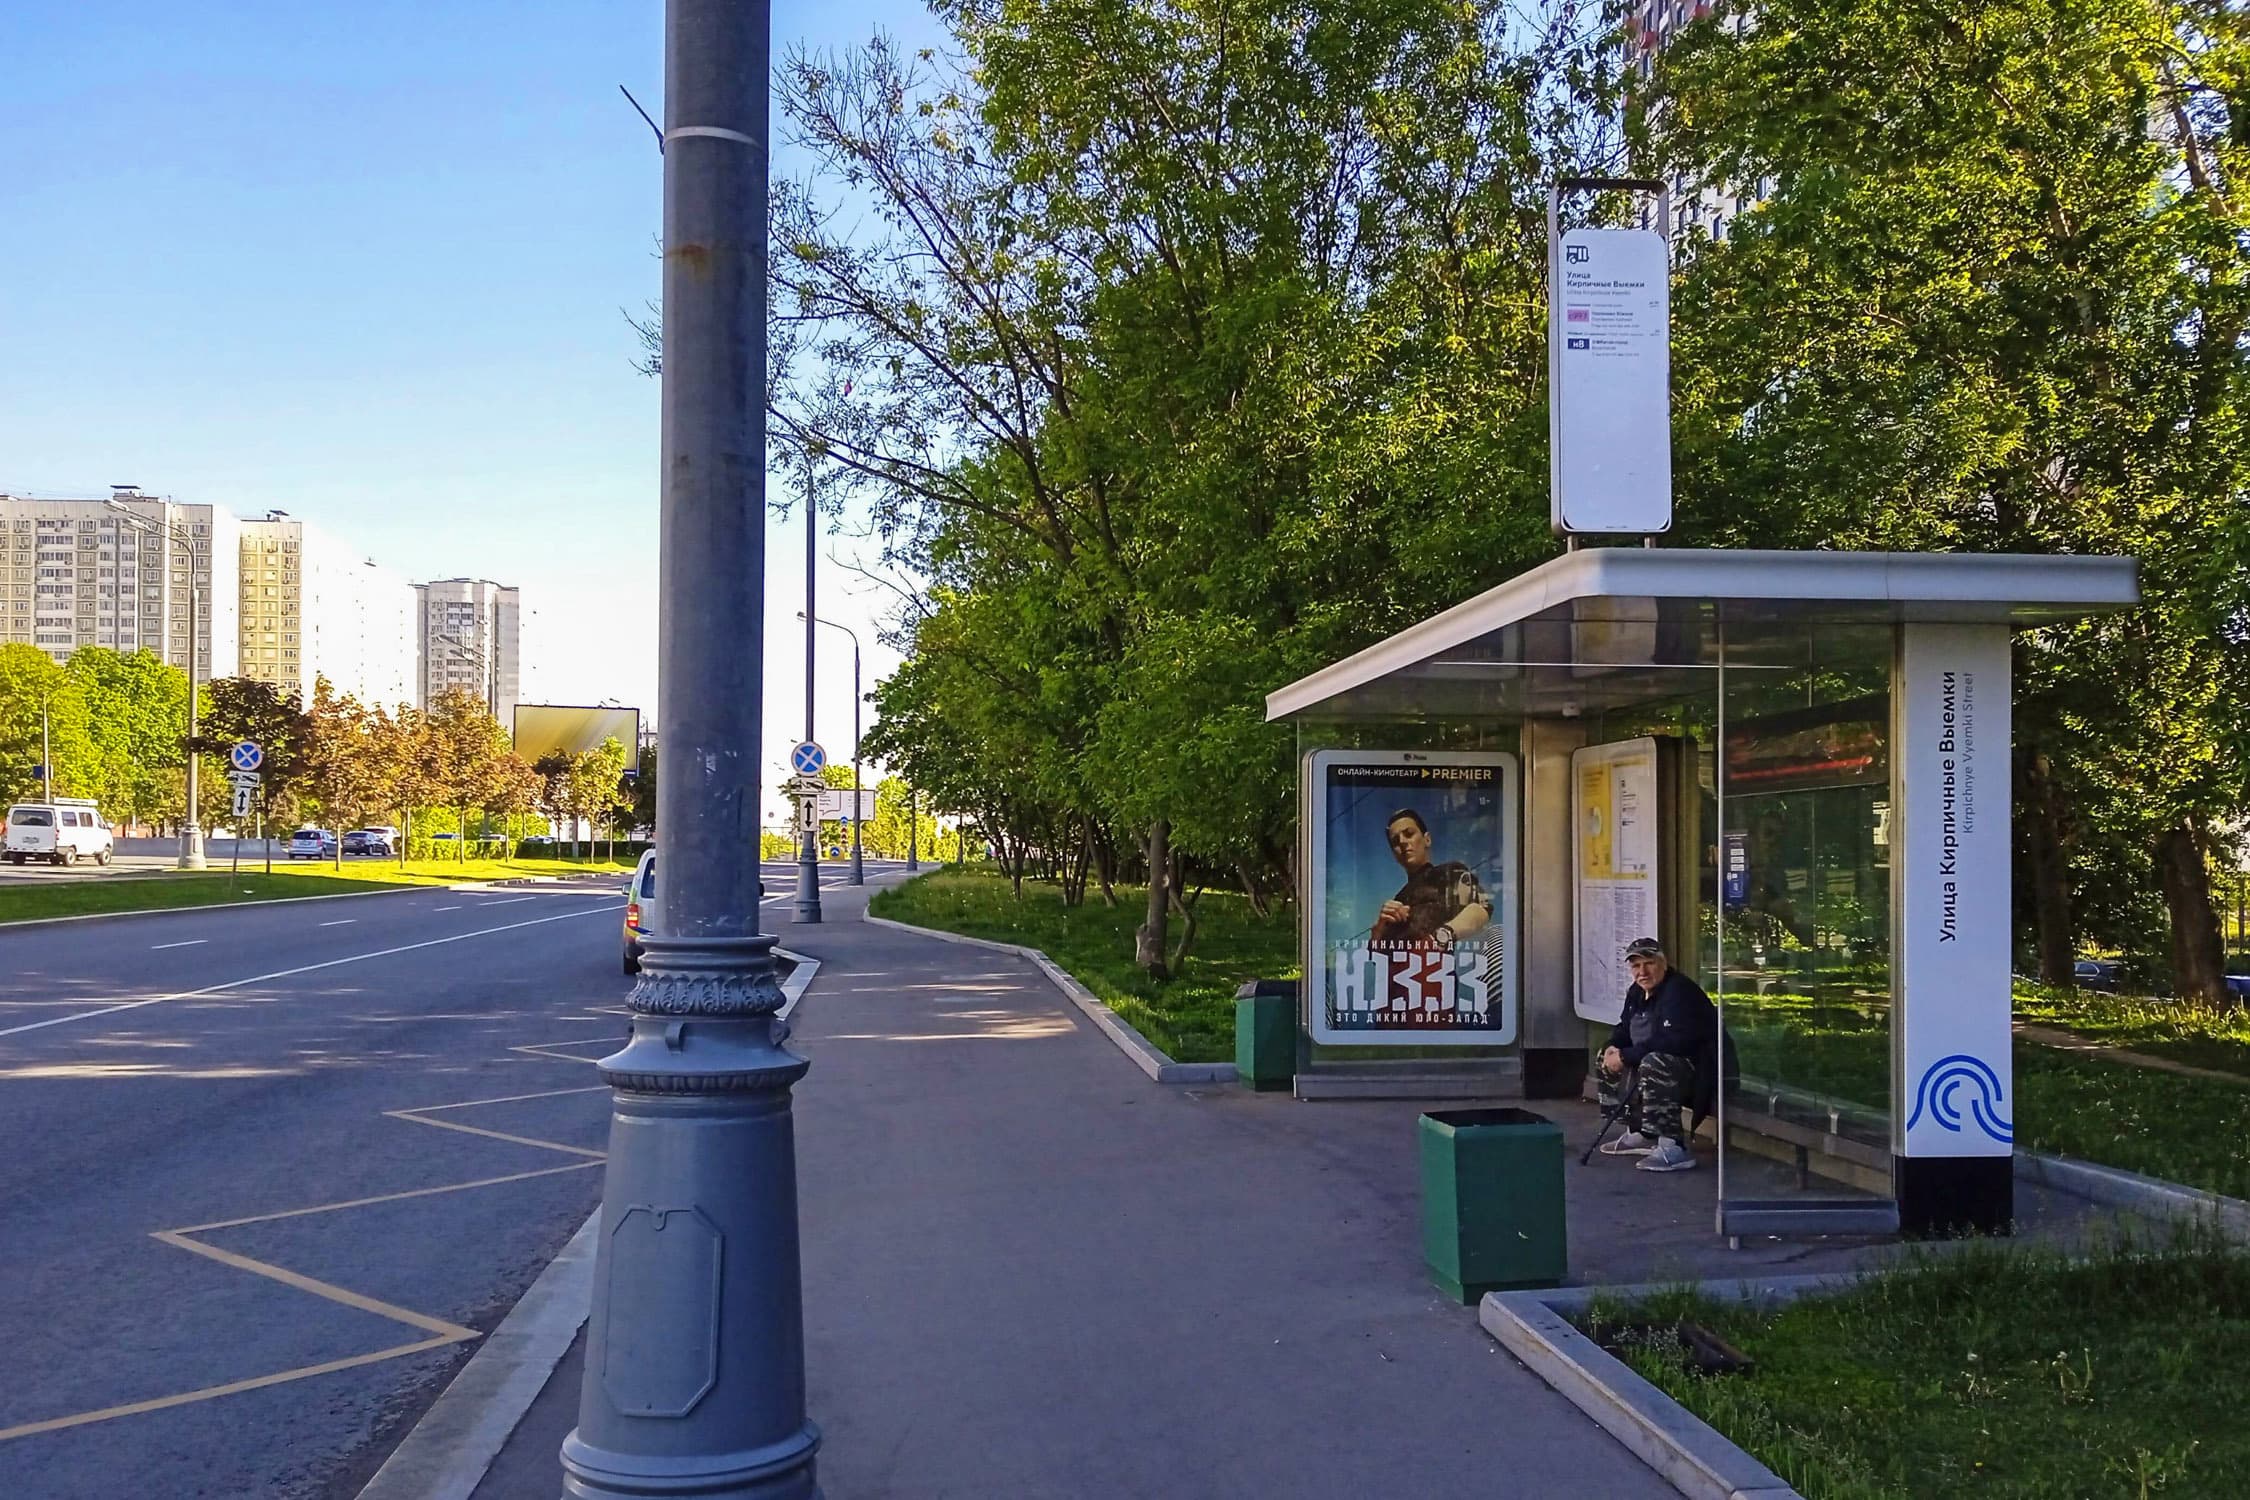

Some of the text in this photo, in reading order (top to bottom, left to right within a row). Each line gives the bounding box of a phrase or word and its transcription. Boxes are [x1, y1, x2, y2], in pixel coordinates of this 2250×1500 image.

[1567, 271, 1591, 279] Улица
[1567, 280, 1645, 288] Кирпичные Выемки
[1962, 672, 1976, 834] Kirpichnye Vyemki Street
[1337, 767, 1419, 777] ОНЛАЙН-КИНОТЕАТР
[1432, 768, 1493, 780] PREMIER
[1939, 671, 1959, 943] Улица Кирпичные Выемки
[1335, 939, 1489, 951] КРИМИНАЛЬНАЯ ДРАМА
[1336, 1013, 1358, 1023] ЭТО
[1366, 1011, 1407, 1024] ДИКИЙ
